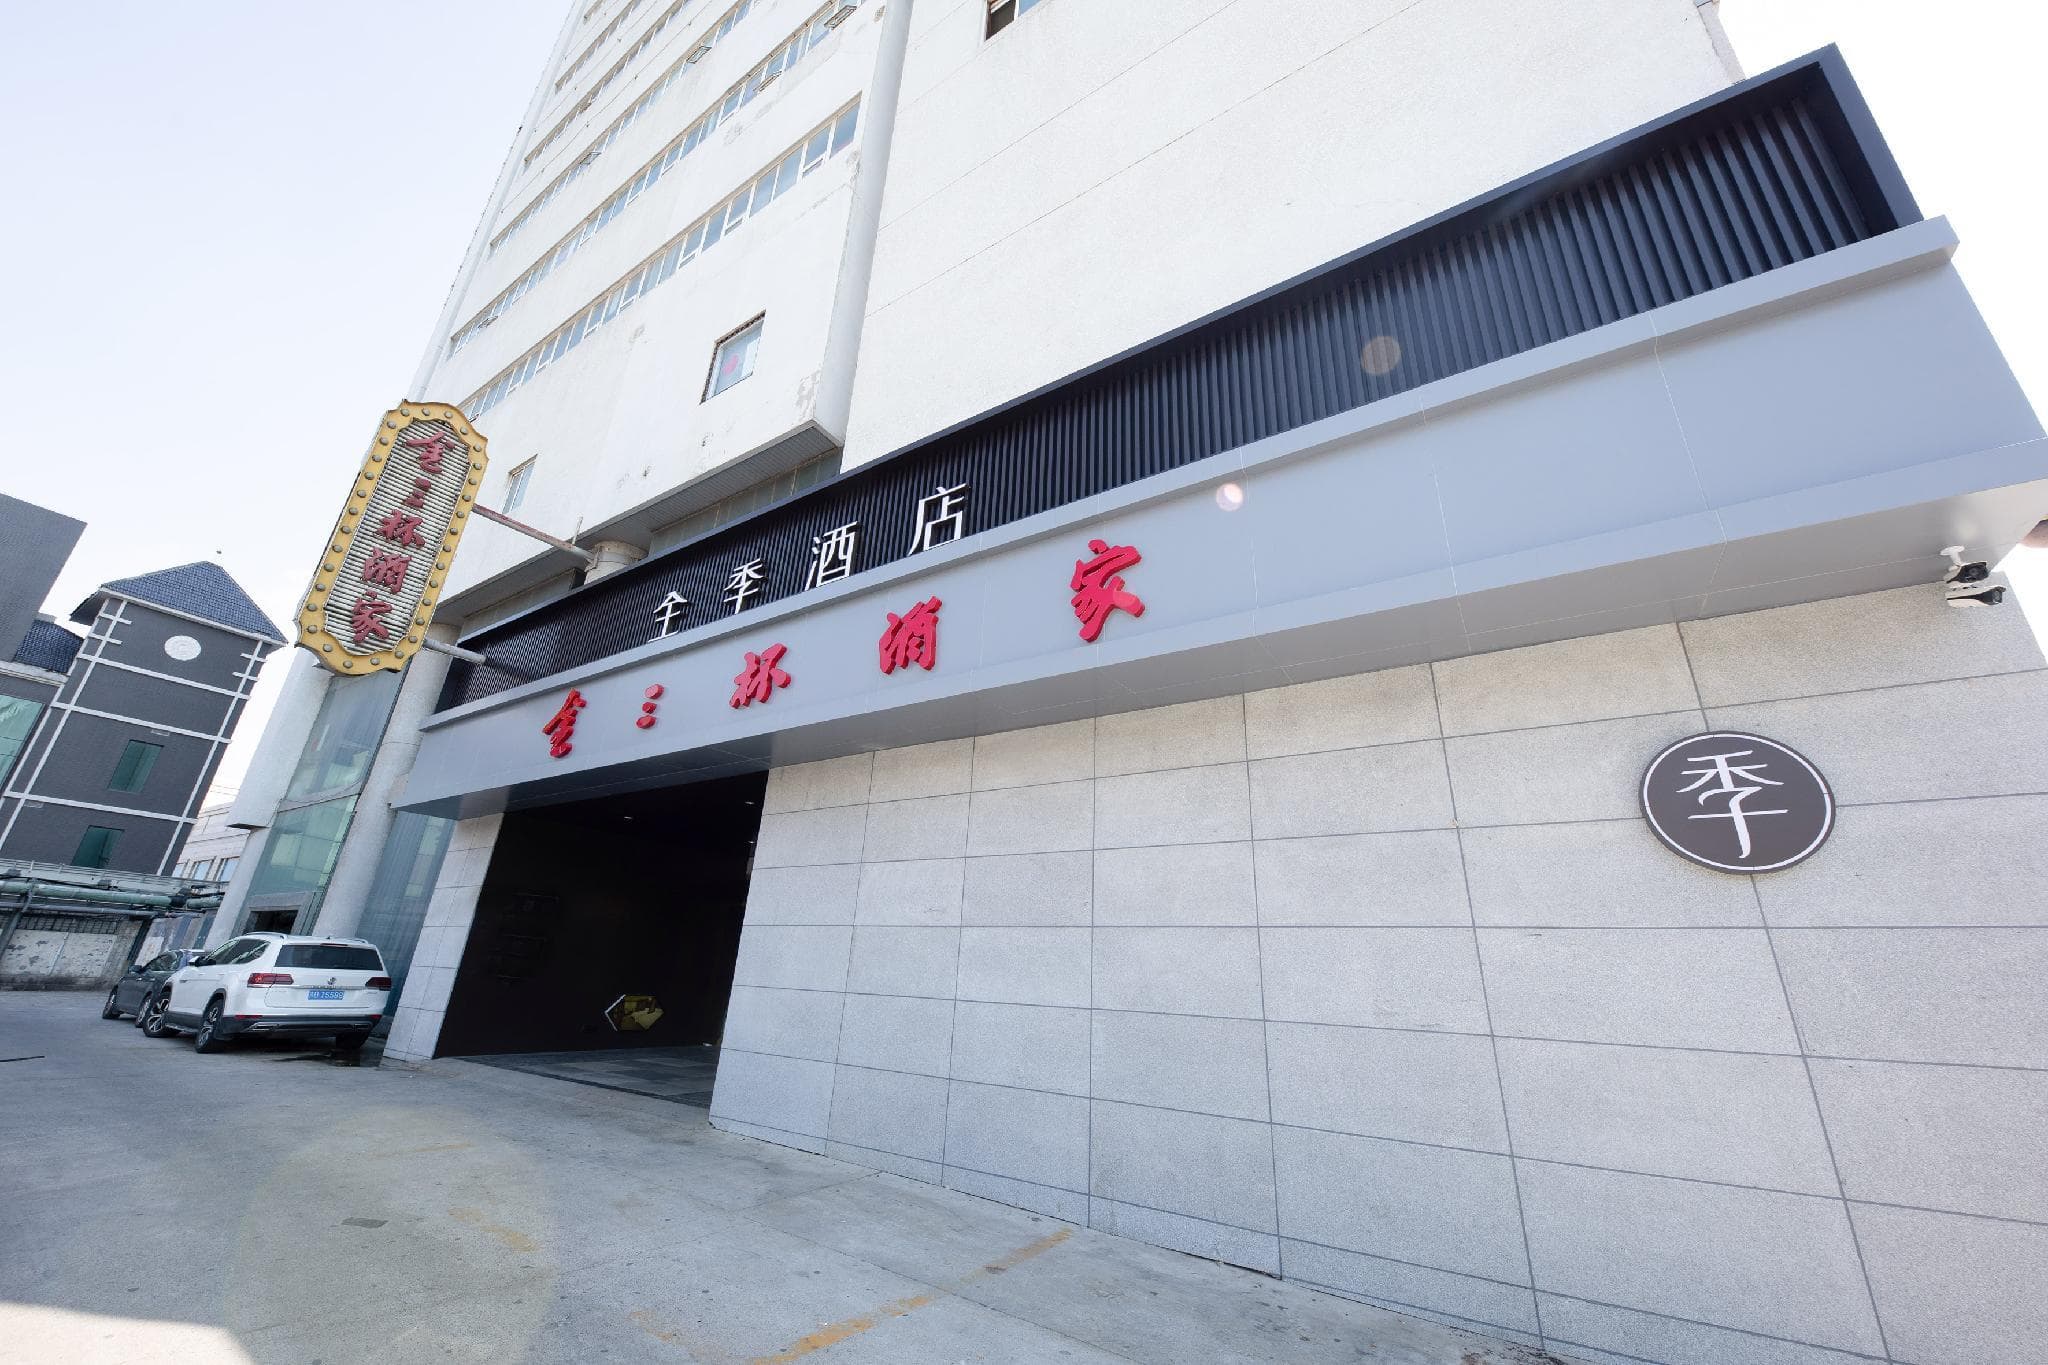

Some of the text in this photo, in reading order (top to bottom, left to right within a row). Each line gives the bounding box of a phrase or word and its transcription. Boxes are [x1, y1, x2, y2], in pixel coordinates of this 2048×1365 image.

[351, 431, 455, 643] 金三杯酒家
[648, 483, 968, 642] 全季酒店
[542, 539, 1145, 758] 金三杯酒家
[1676, 750, 1788, 858] 季
